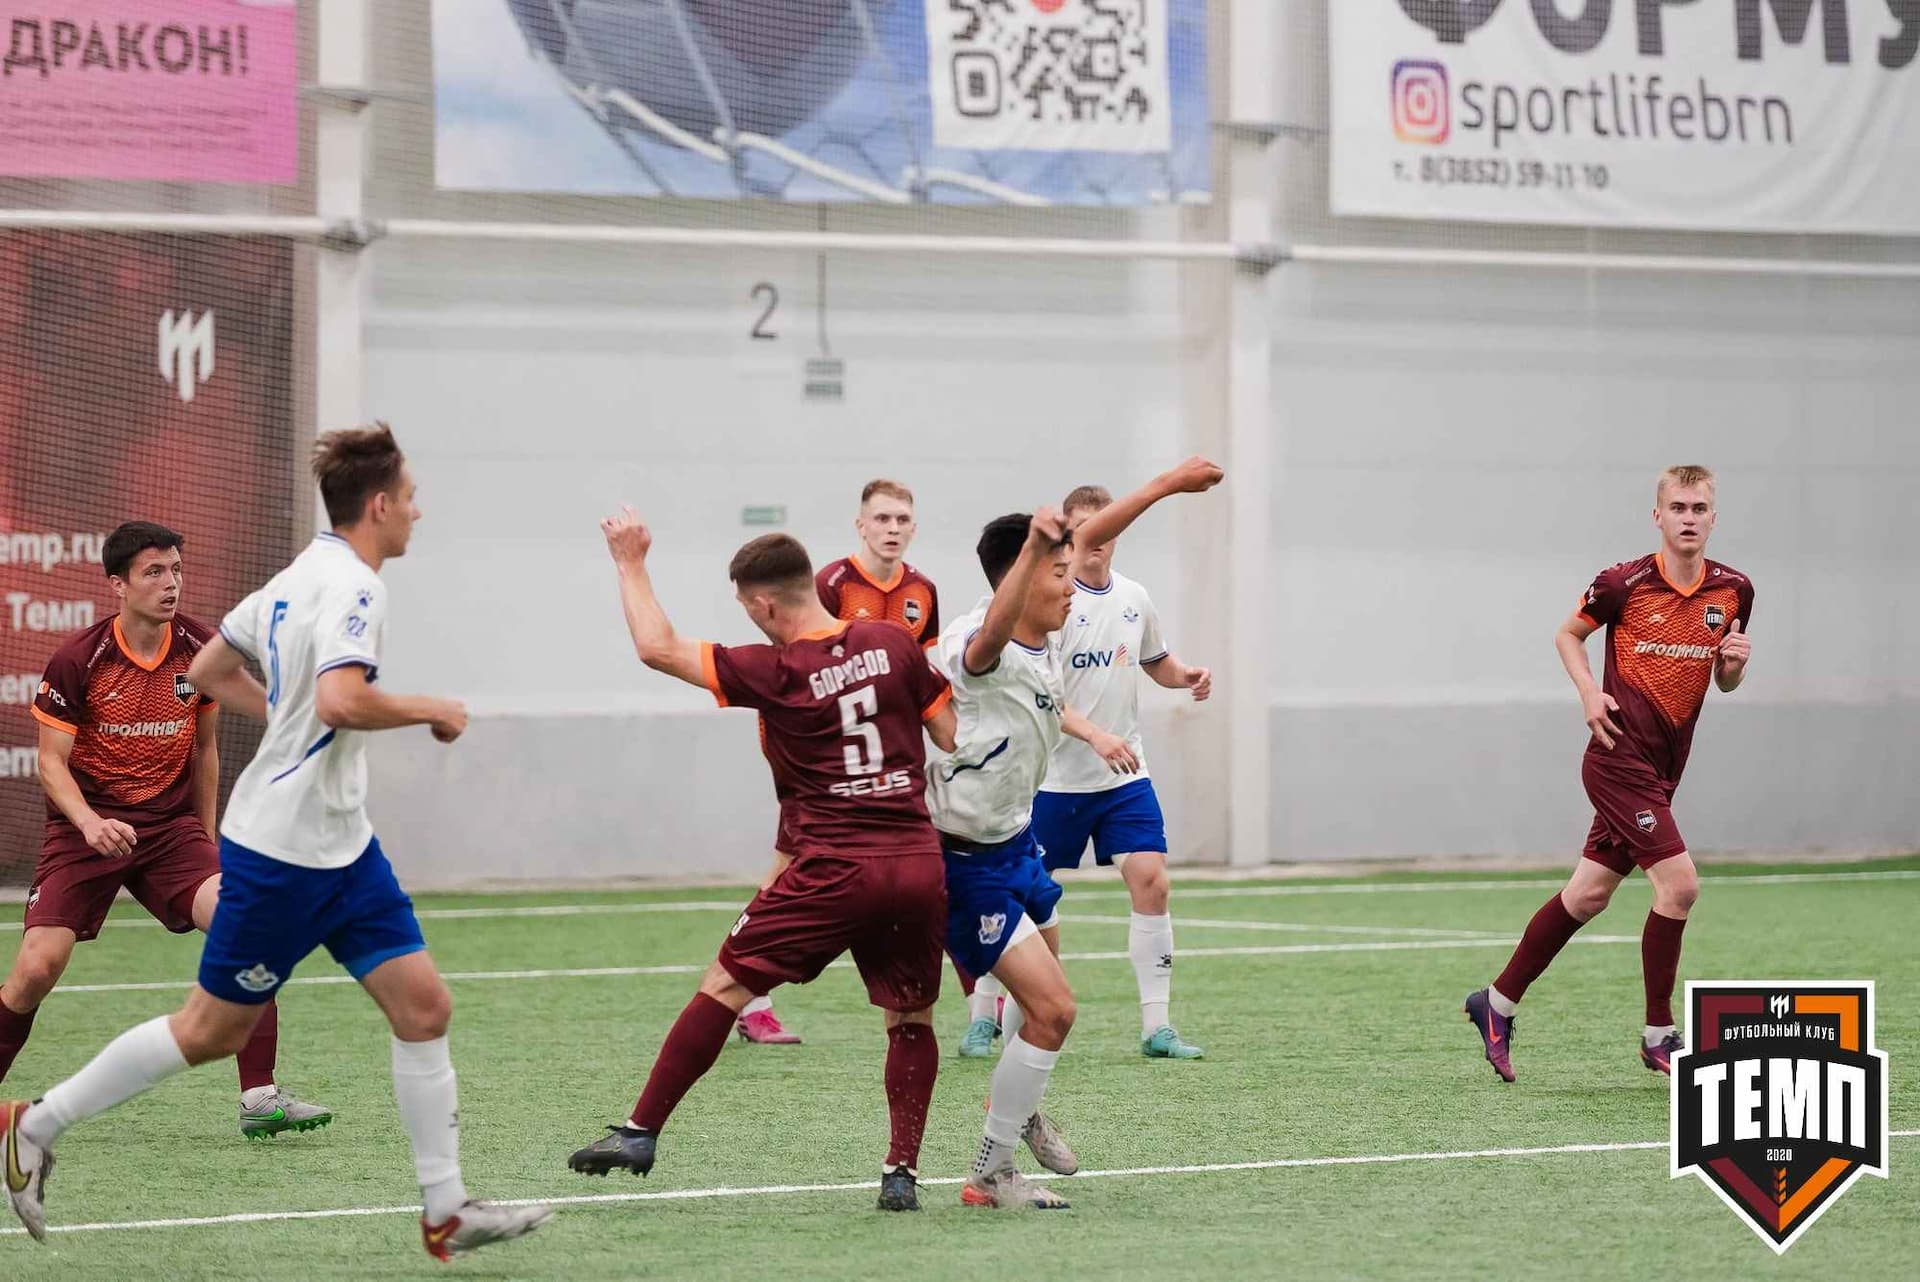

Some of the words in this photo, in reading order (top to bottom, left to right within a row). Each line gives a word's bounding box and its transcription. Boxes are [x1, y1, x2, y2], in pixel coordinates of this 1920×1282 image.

[3, 18, 249, 77] ДРАКОН!
[1460, 73, 1793, 148] sportlifebrn
[750, 282, 779, 339] 2
[6, 592, 95, 631] Темп
[1072, 650, 1113, 669] GNV
[837, 684, 884, 776] 5
[829, 769, 912, 797] SEUS
